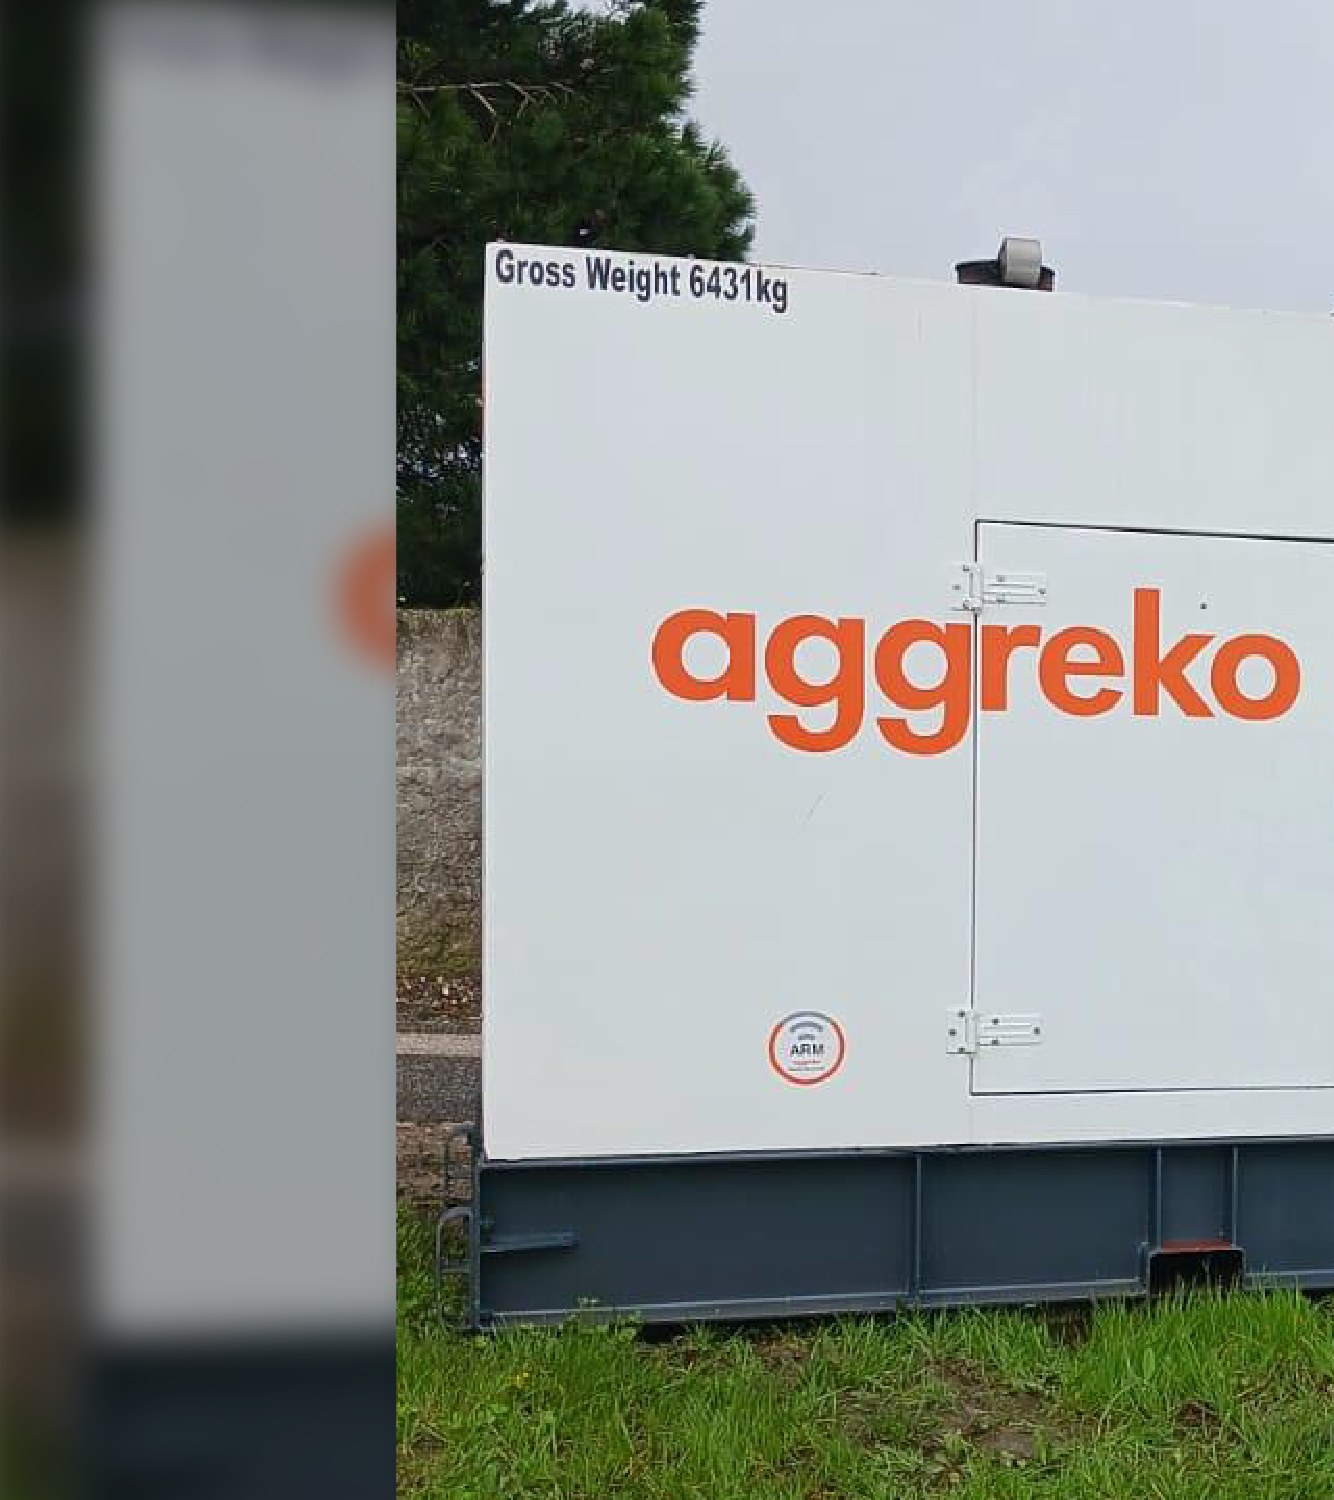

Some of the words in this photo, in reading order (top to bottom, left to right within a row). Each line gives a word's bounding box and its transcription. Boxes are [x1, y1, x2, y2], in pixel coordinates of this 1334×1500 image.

[495, 248, 576, 289] Gross
[585, 255, 681, 302] Weight
[689, 264, 788, 314] 6431kg
[652, 587, 1300, 756] aggreko
[790, 1043, 825, 1056] ARM
